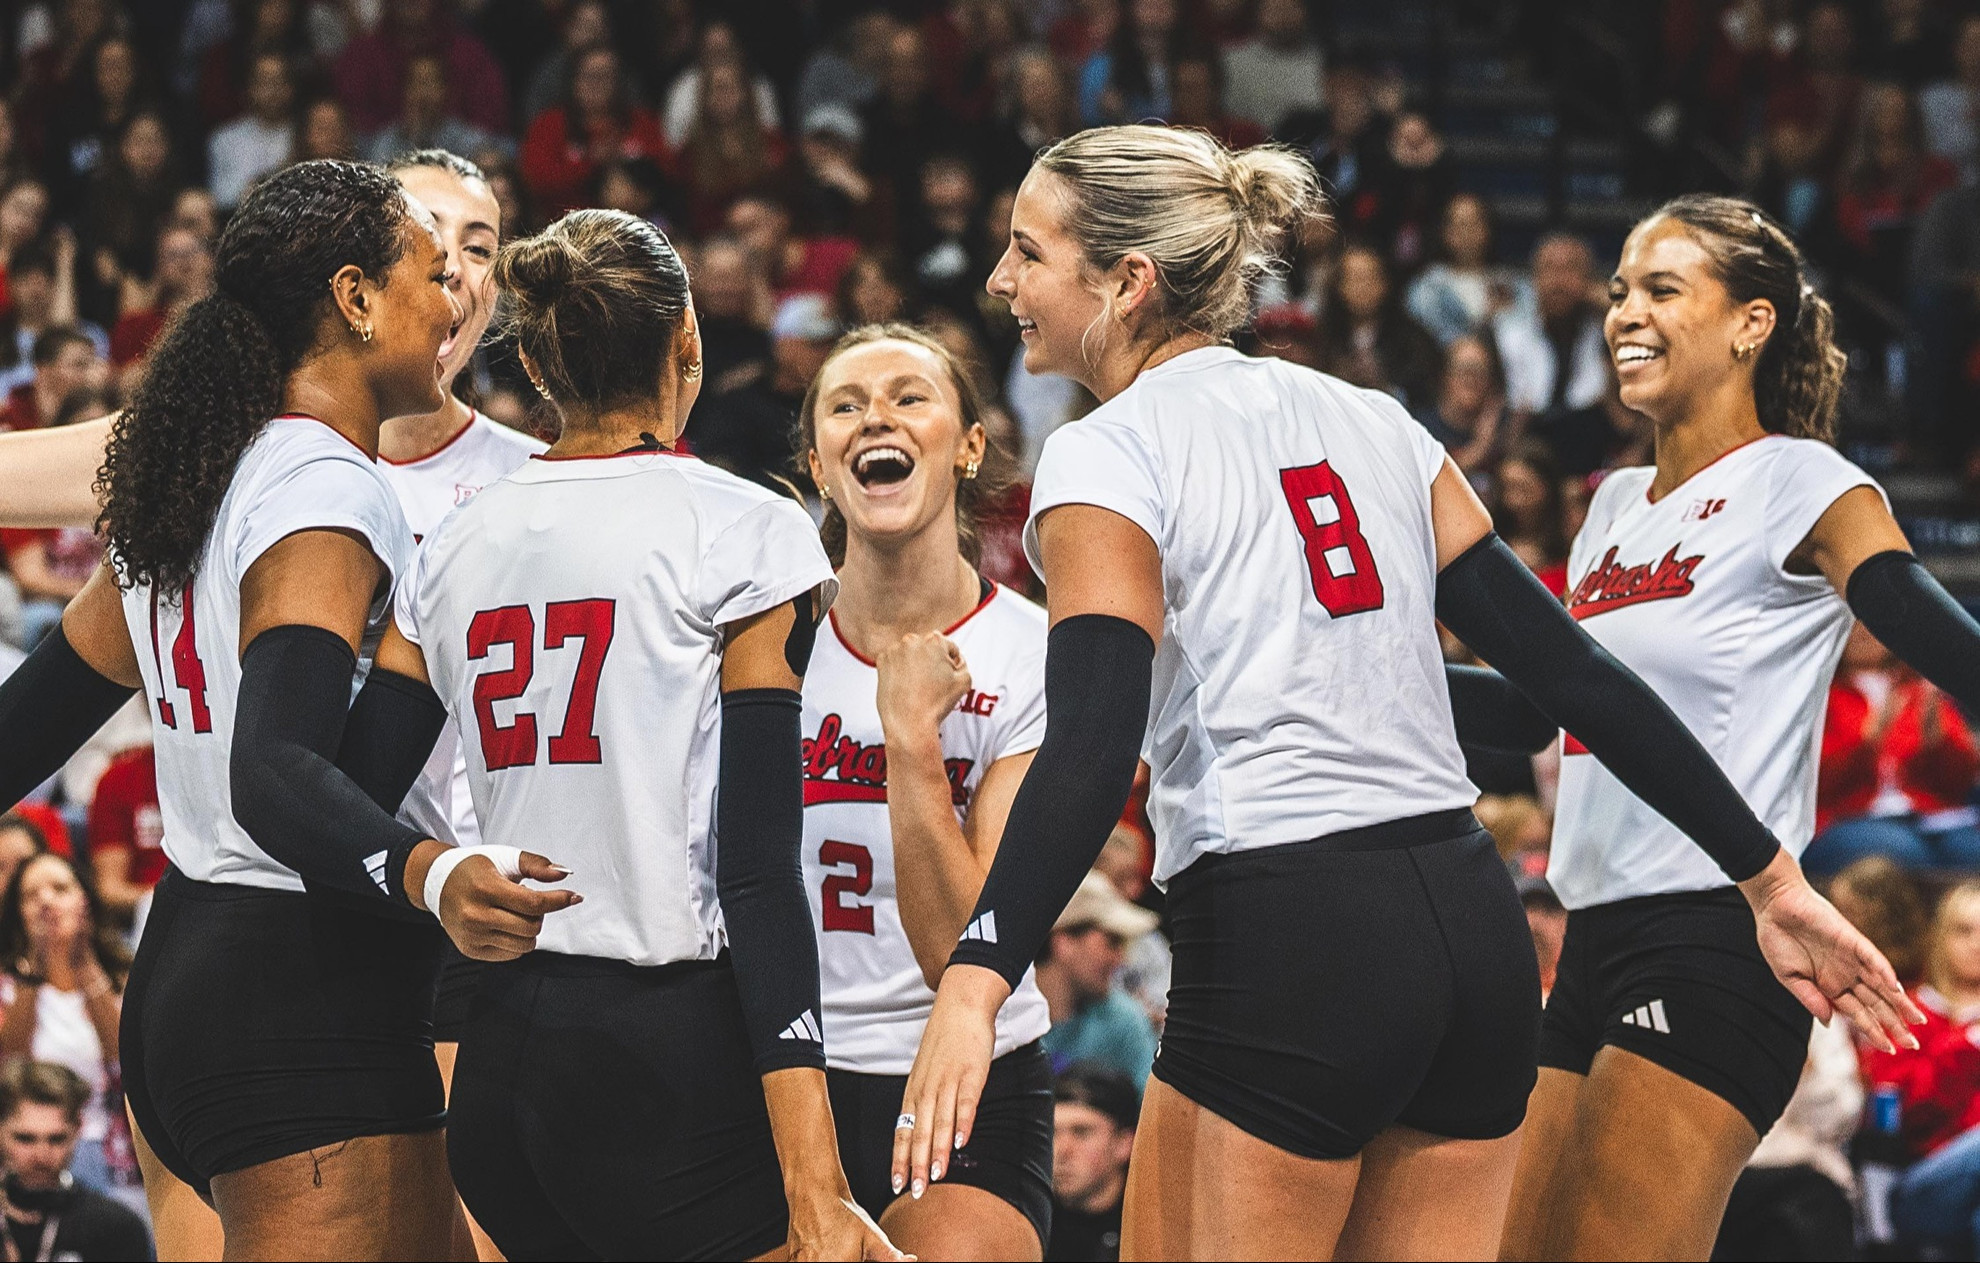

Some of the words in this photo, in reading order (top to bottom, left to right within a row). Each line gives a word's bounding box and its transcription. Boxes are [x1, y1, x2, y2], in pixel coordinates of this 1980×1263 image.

[1279, 458, 1384, 619] 8
[466, 597, 617, 772] 27
[955, 688, 999, 718] IG
[818, 838, 876, 936] 2
